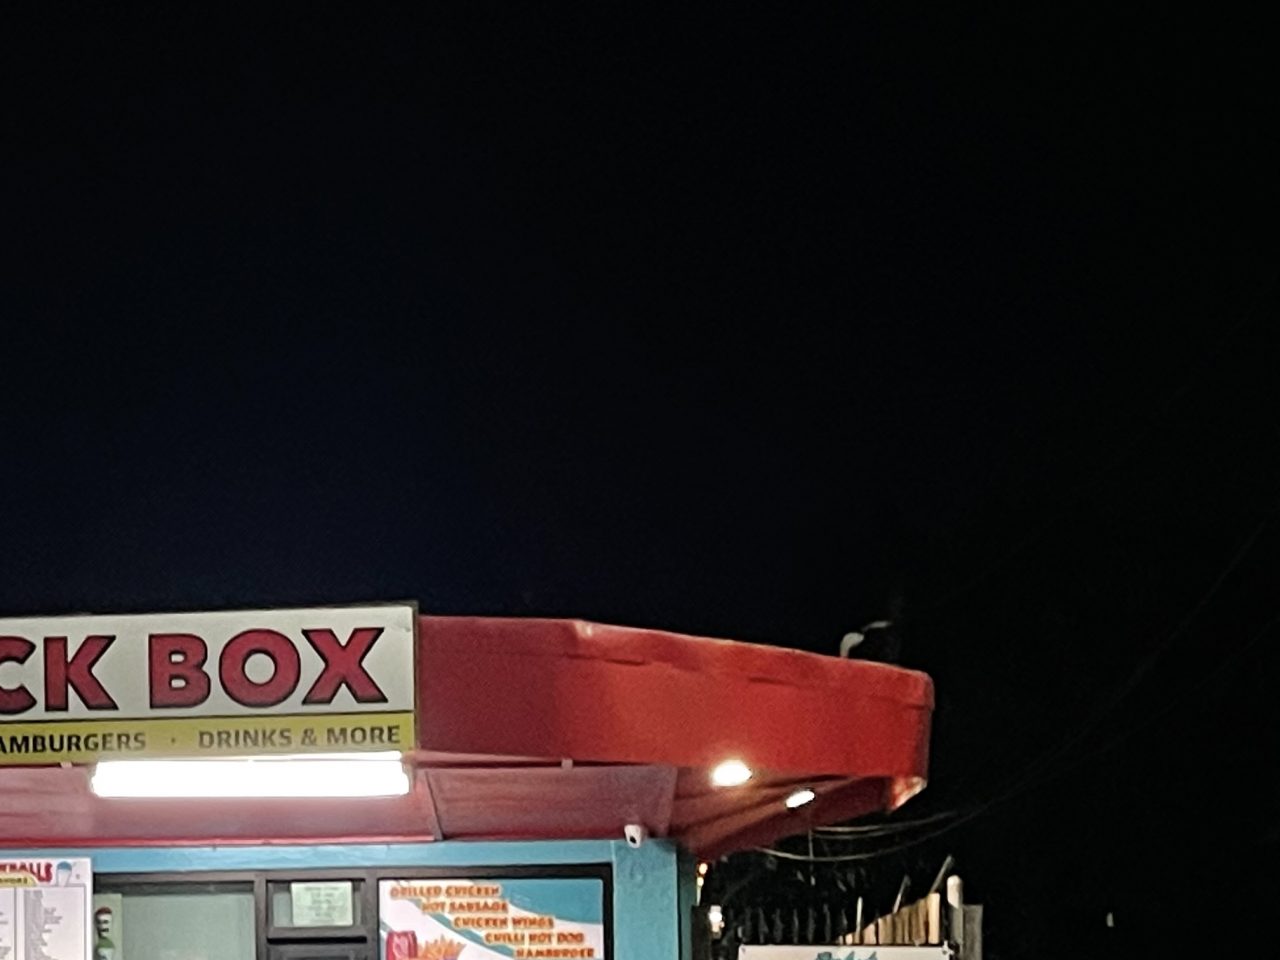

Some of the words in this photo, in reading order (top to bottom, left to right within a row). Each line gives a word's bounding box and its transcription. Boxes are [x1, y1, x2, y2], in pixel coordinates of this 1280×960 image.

[148, 627, 389, 709] BOX
[198, 728, 294, 750] DRINKS
[300, 727, 318, 747] &
[325, 724, 401, 746] MORE
